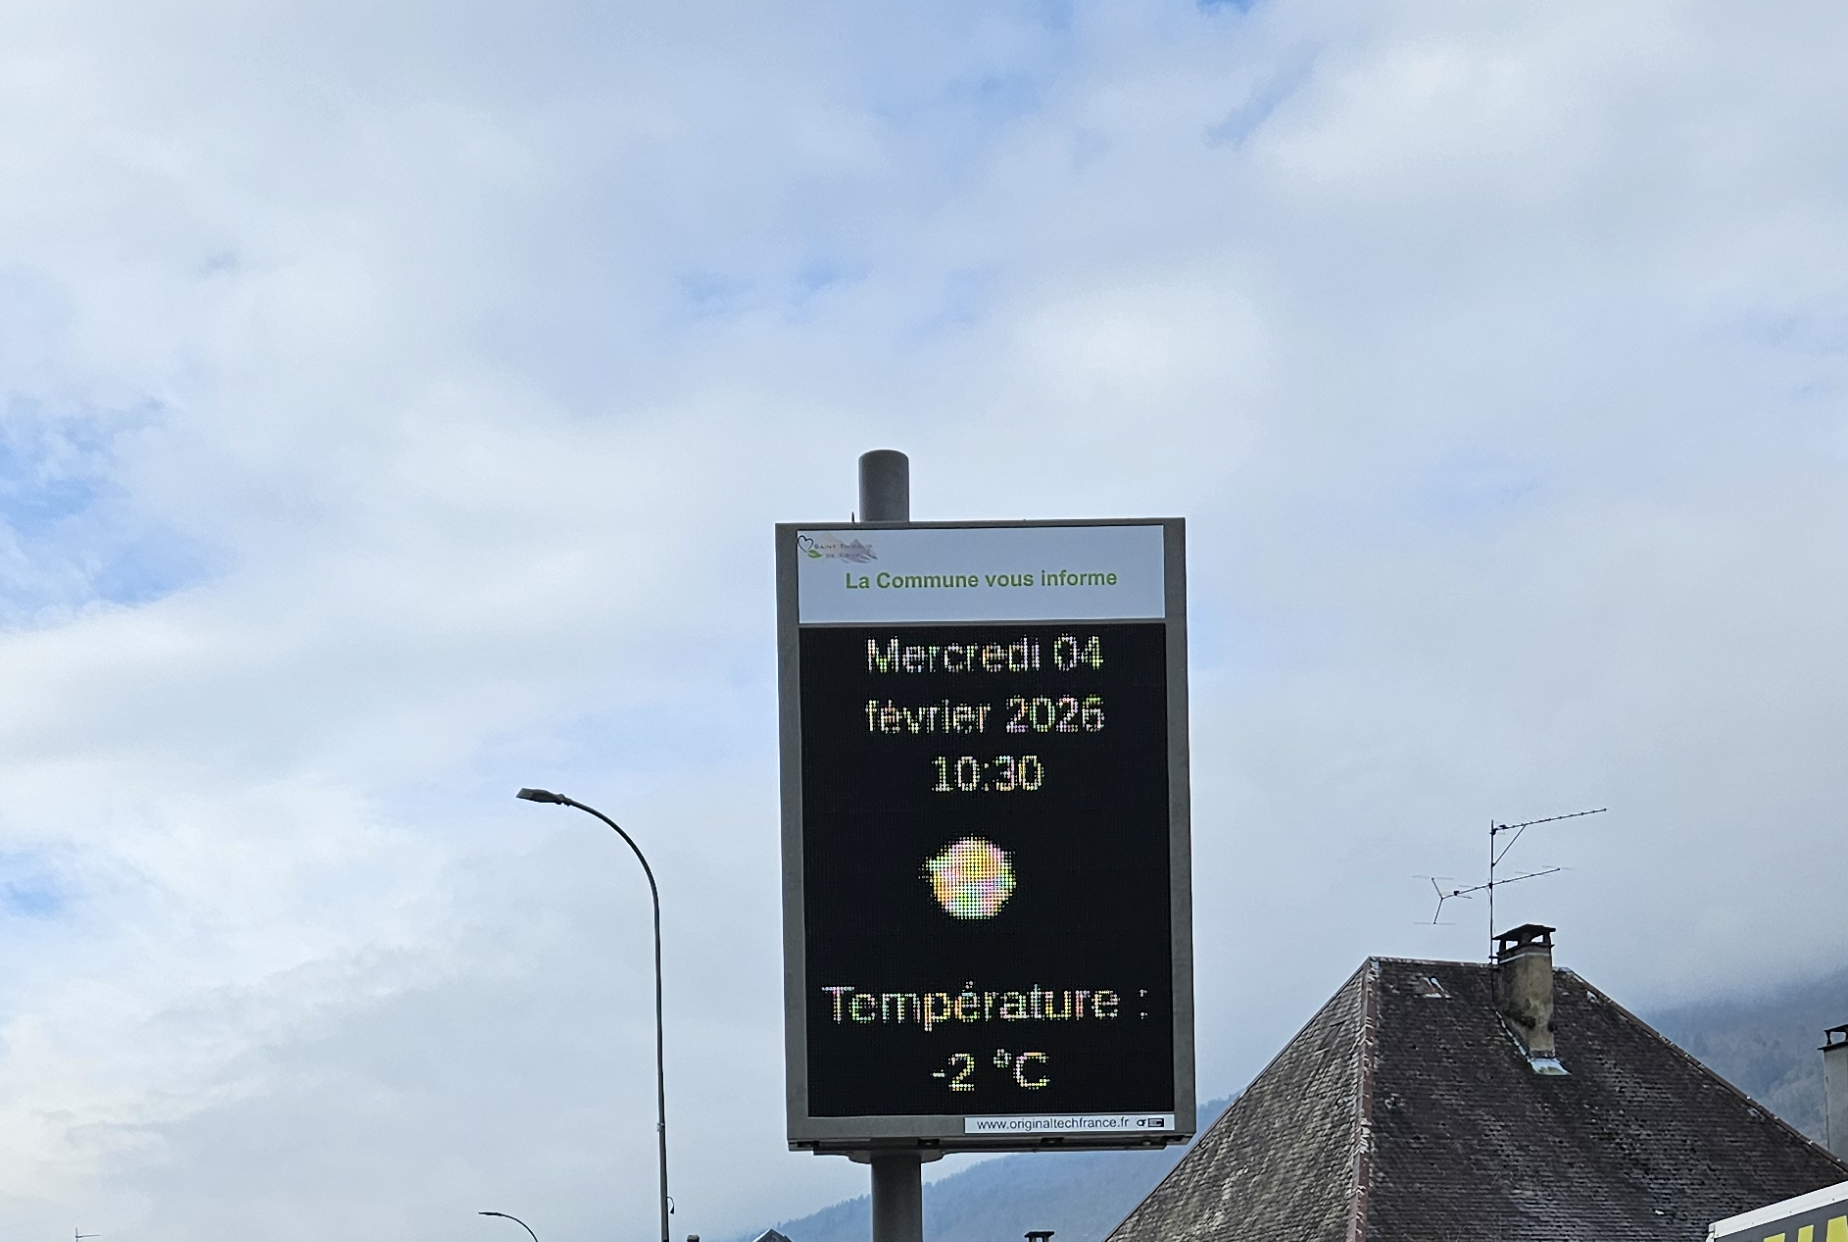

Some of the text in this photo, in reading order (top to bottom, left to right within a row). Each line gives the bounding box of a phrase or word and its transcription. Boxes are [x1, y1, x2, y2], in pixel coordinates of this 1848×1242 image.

[845, 569, 1117, 589] La Commune vous informe
[865, 633, 1104, 674] Mercredi 04
[864, 694, 1105, 735] février 2026
[931, 754, 1045, 792] 10:30
[820, 980, 1121, 1032] Température
[931, 1048, 1051, 1092] -2 °C
[976, 1116, 1130, 1131] www.originaltechfrance.fr
